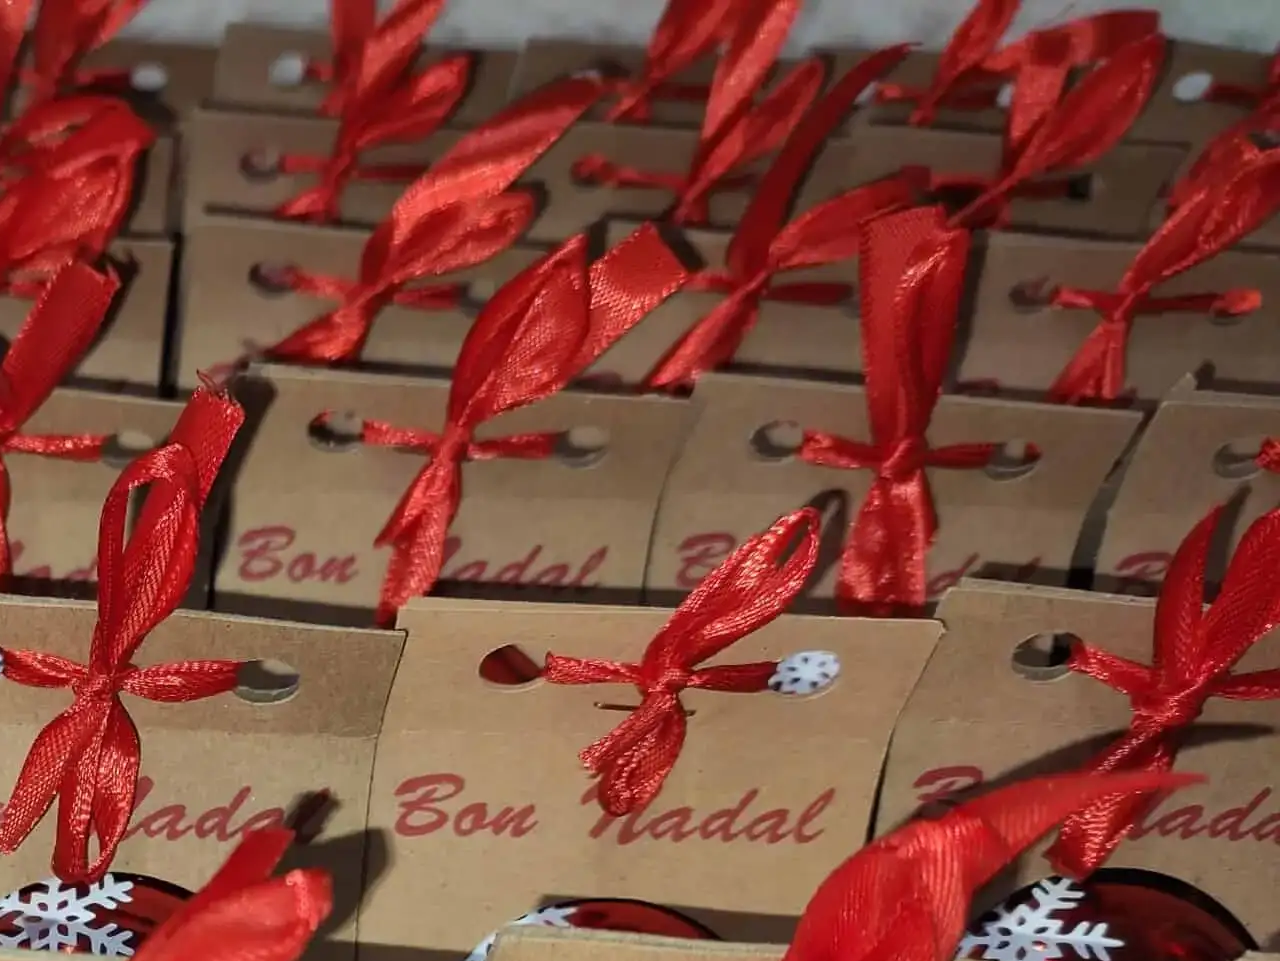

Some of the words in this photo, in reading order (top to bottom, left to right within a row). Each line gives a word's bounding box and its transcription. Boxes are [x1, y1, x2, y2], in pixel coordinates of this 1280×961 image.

[237, 525, 358, 584] Bon
[442, 535, 609, 590] adal
[394, 772, 539, 839] Bon
